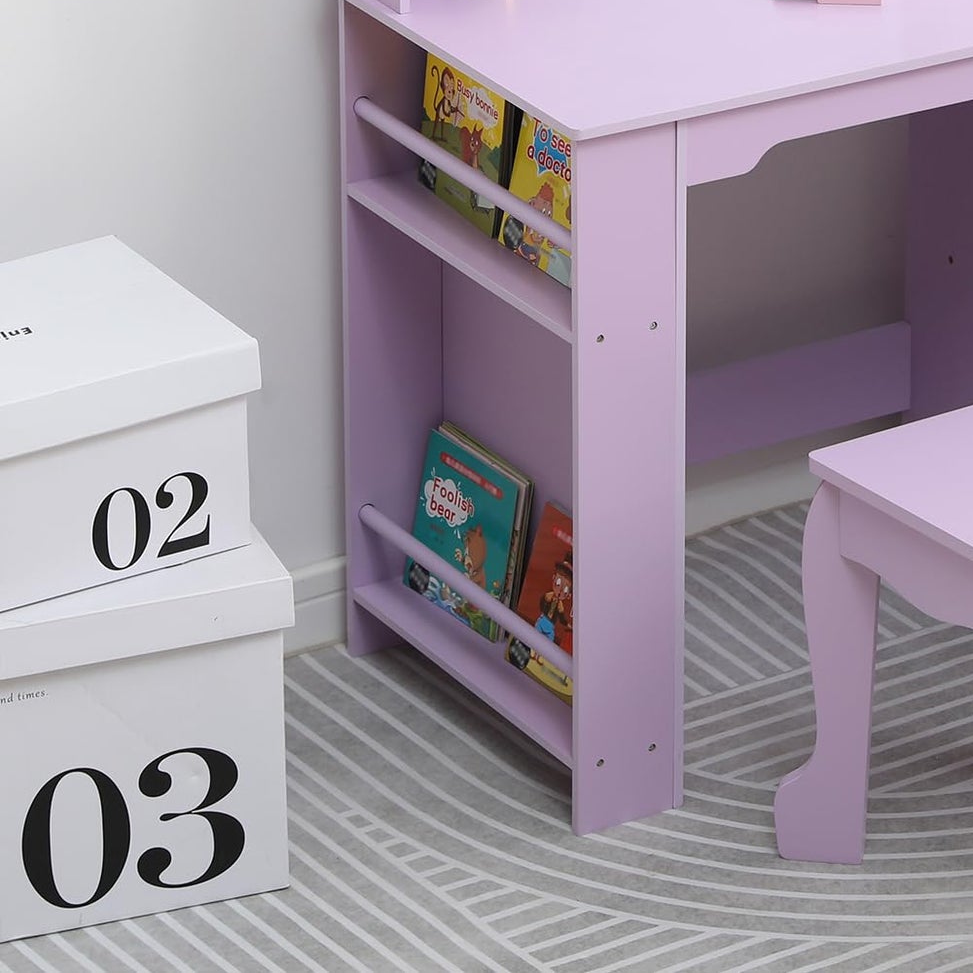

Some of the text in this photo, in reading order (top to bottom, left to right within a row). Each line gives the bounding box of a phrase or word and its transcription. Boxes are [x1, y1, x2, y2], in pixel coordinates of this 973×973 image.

[456, 79, 499, 120] Busy bonnie
[527, 145, 535, 159] a
[533, 116, 572, 158] To see
[430, 493, 456, 523] bear
[433, 477, 474, 515] Foolish
[92, 471, 210, 571] 02
[17, 690, 49, 701] times.
[21, 747, 246, 909] 03
